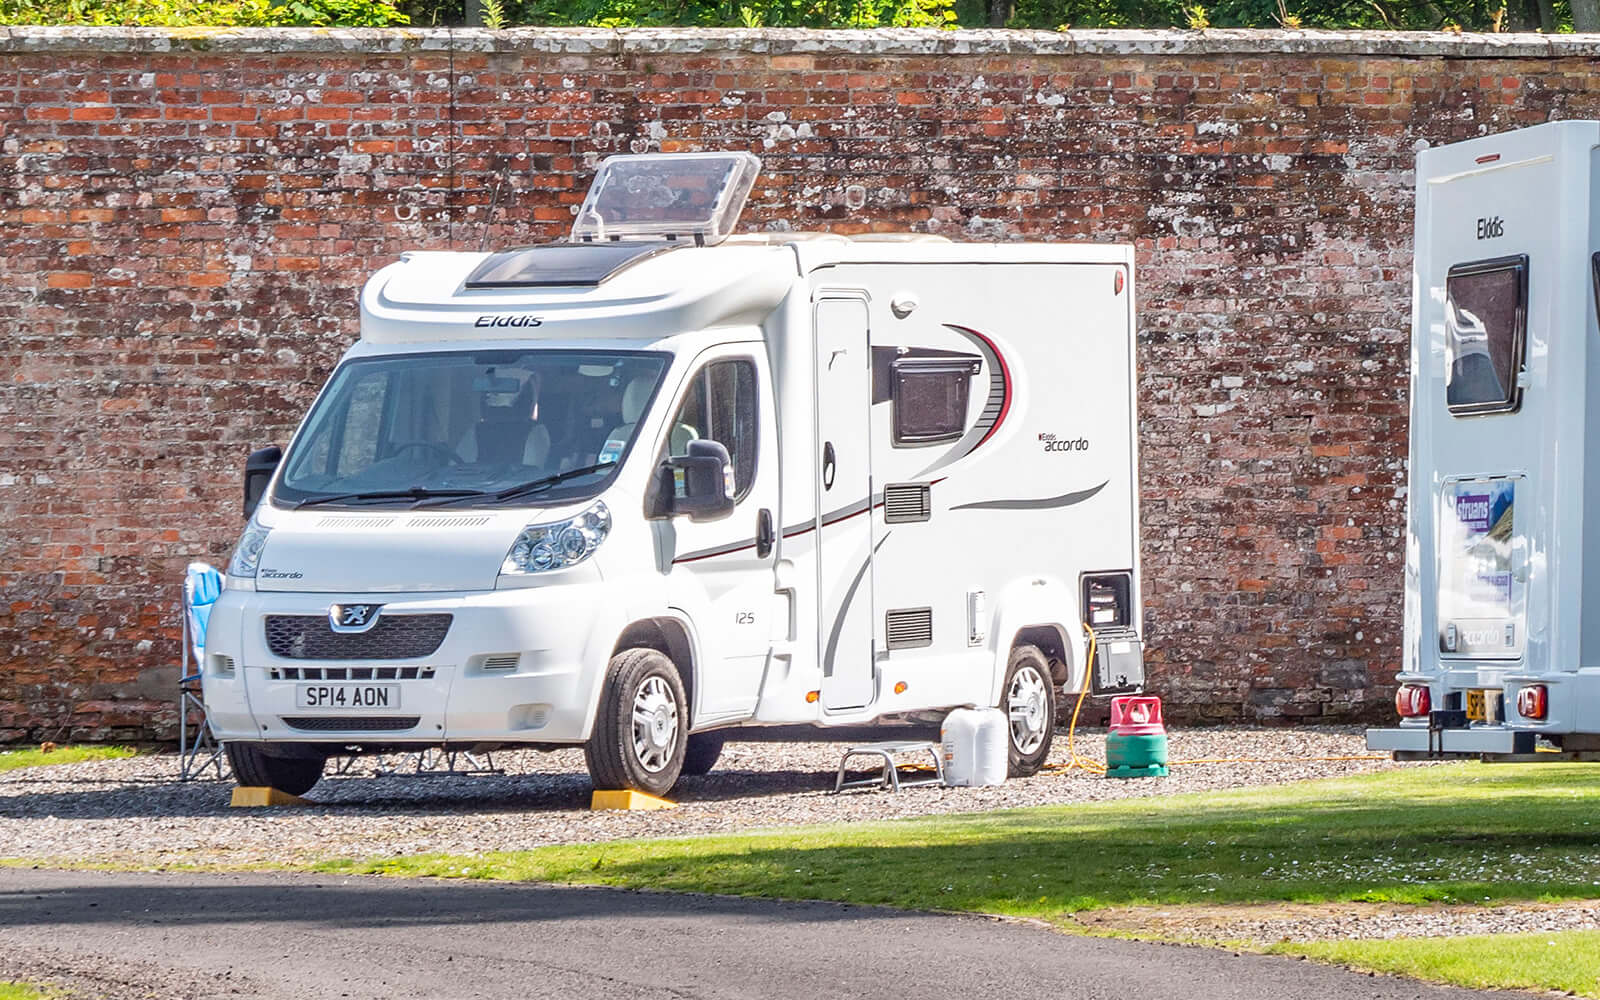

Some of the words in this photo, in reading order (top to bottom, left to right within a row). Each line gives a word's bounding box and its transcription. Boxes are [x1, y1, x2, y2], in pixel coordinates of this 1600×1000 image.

[1477, 216, 1504, 240] Elddis
[474, 315, 544, 328] Elddis
[1044, 436, 1089, 452] accordo
[736, 611, 755, 624] 125
[306, 687, 346, 706] SP14
[352, 687, 388, 706] AON
